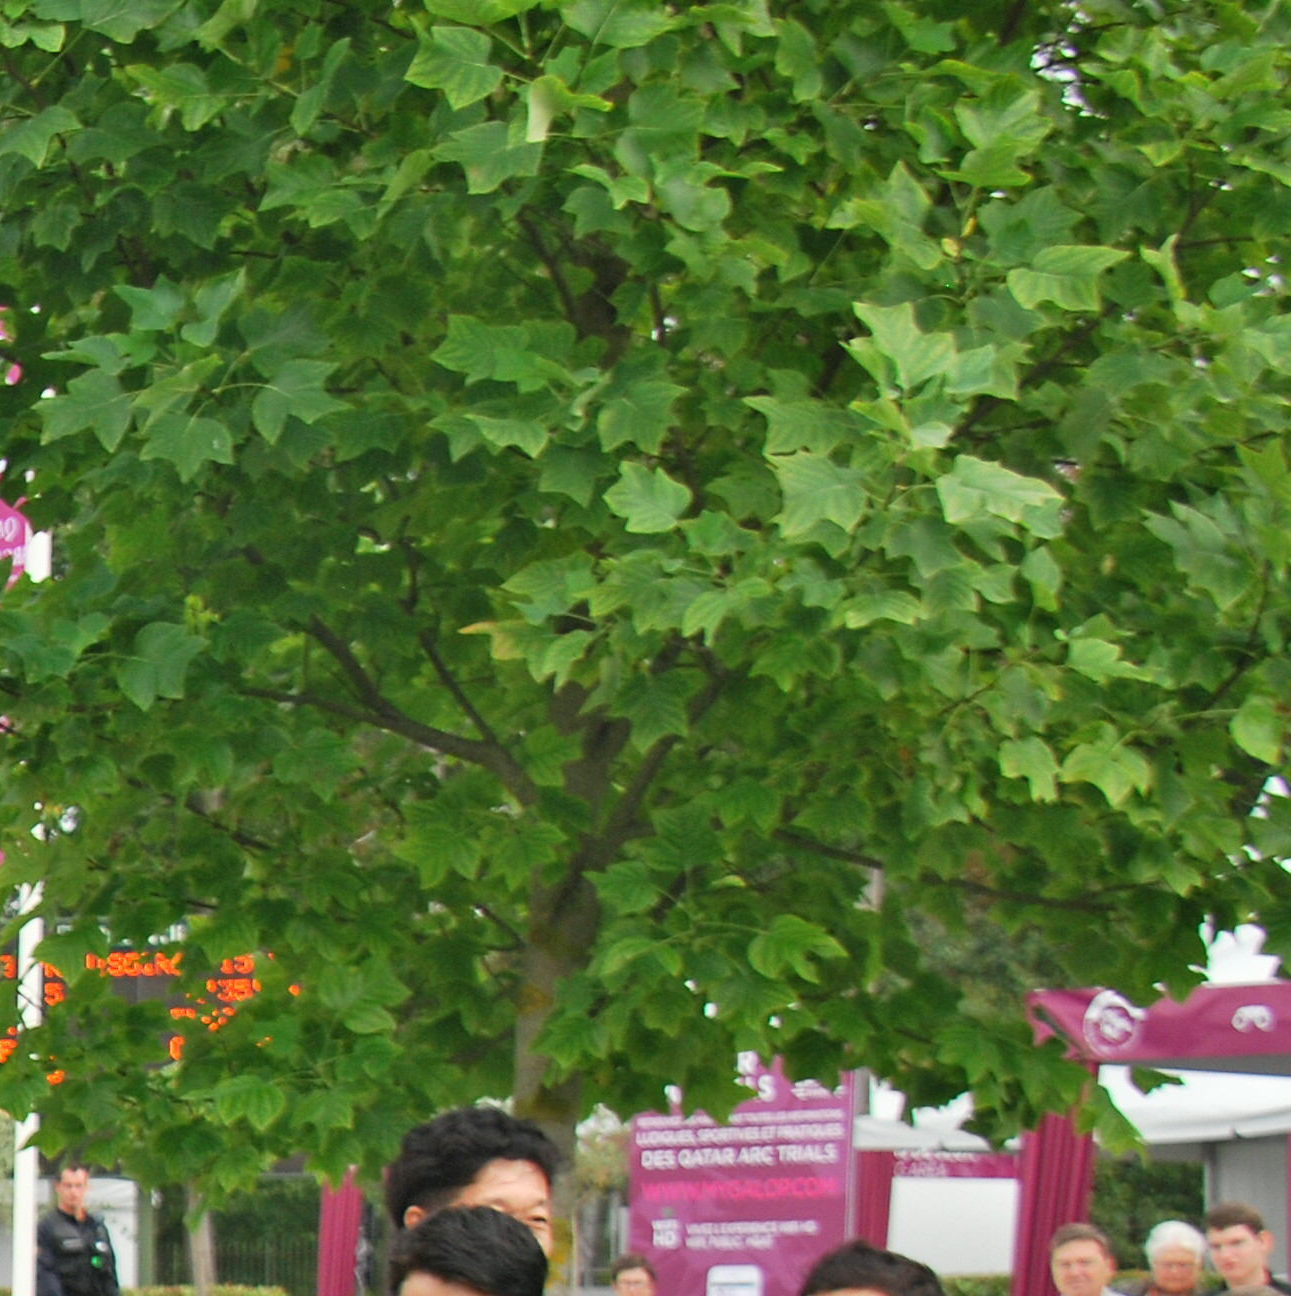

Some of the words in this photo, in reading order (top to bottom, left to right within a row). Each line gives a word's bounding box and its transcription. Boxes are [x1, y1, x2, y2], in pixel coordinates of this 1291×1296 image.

[641, 1151, 675, 1170] DES
[677, 1147, 735, 1169] QATAR
[738, 1145, 774, 1166] ARC
[777, 1143, 837, 1164] TRIALS
